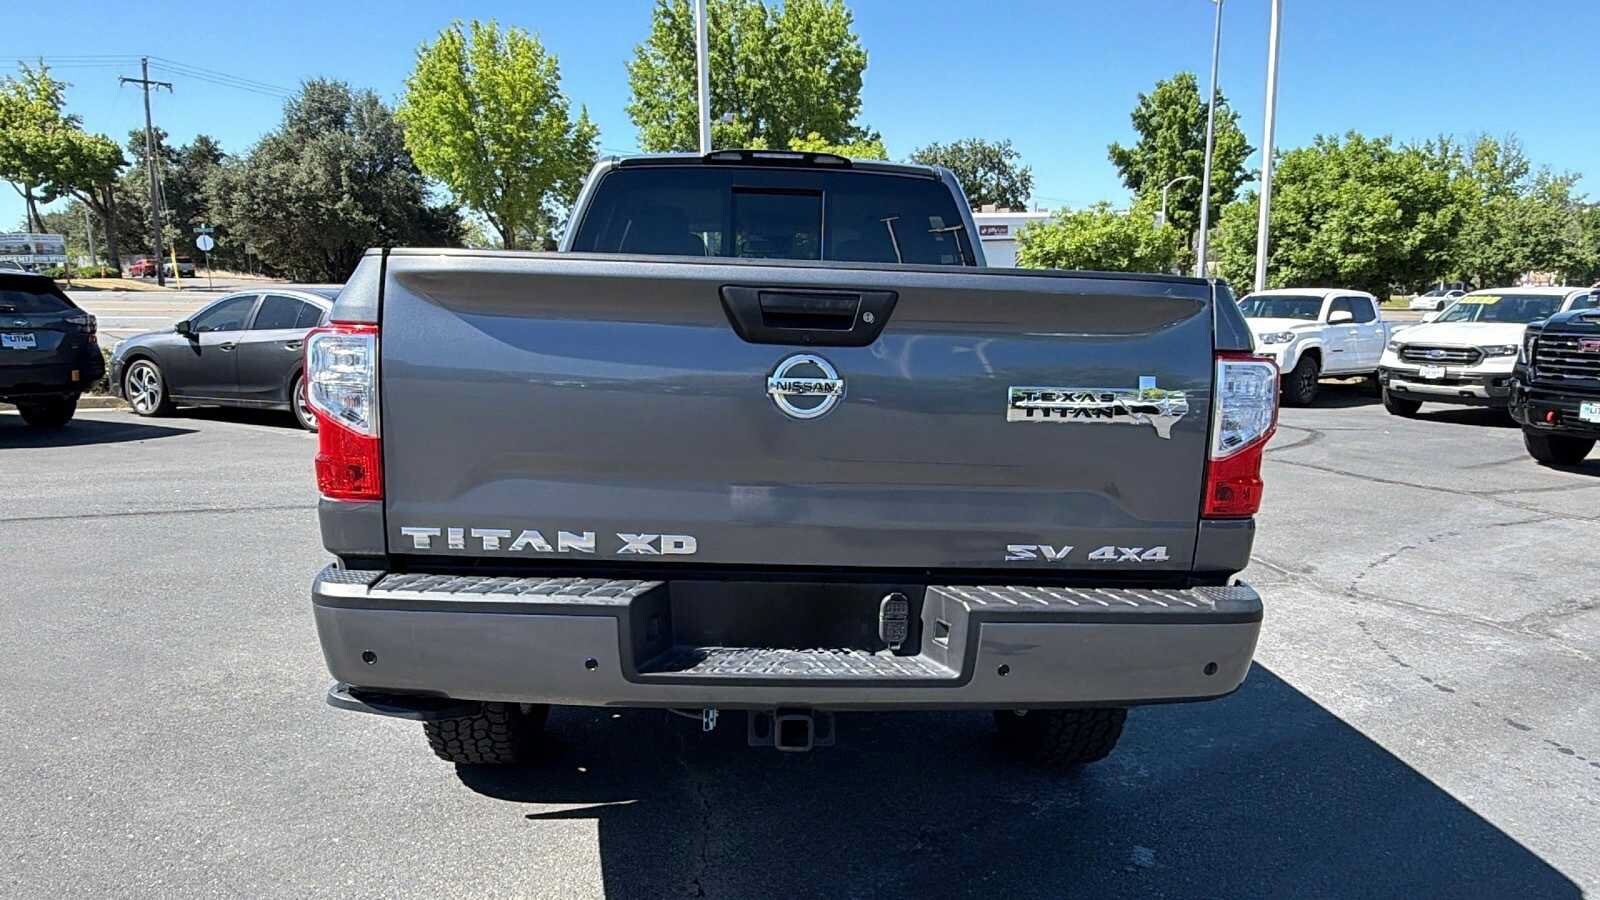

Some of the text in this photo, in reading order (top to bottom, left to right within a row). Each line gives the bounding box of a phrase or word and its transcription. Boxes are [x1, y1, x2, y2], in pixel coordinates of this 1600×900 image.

[776, 381, 835, 393] NISSAN
[1021, 391, 1115, 402] TEXAS
[1024, 406, 1113, 418] TITAN
[401, 527, 698, 555] TITAN XD
[1004, 544, 1075, 562] SV
